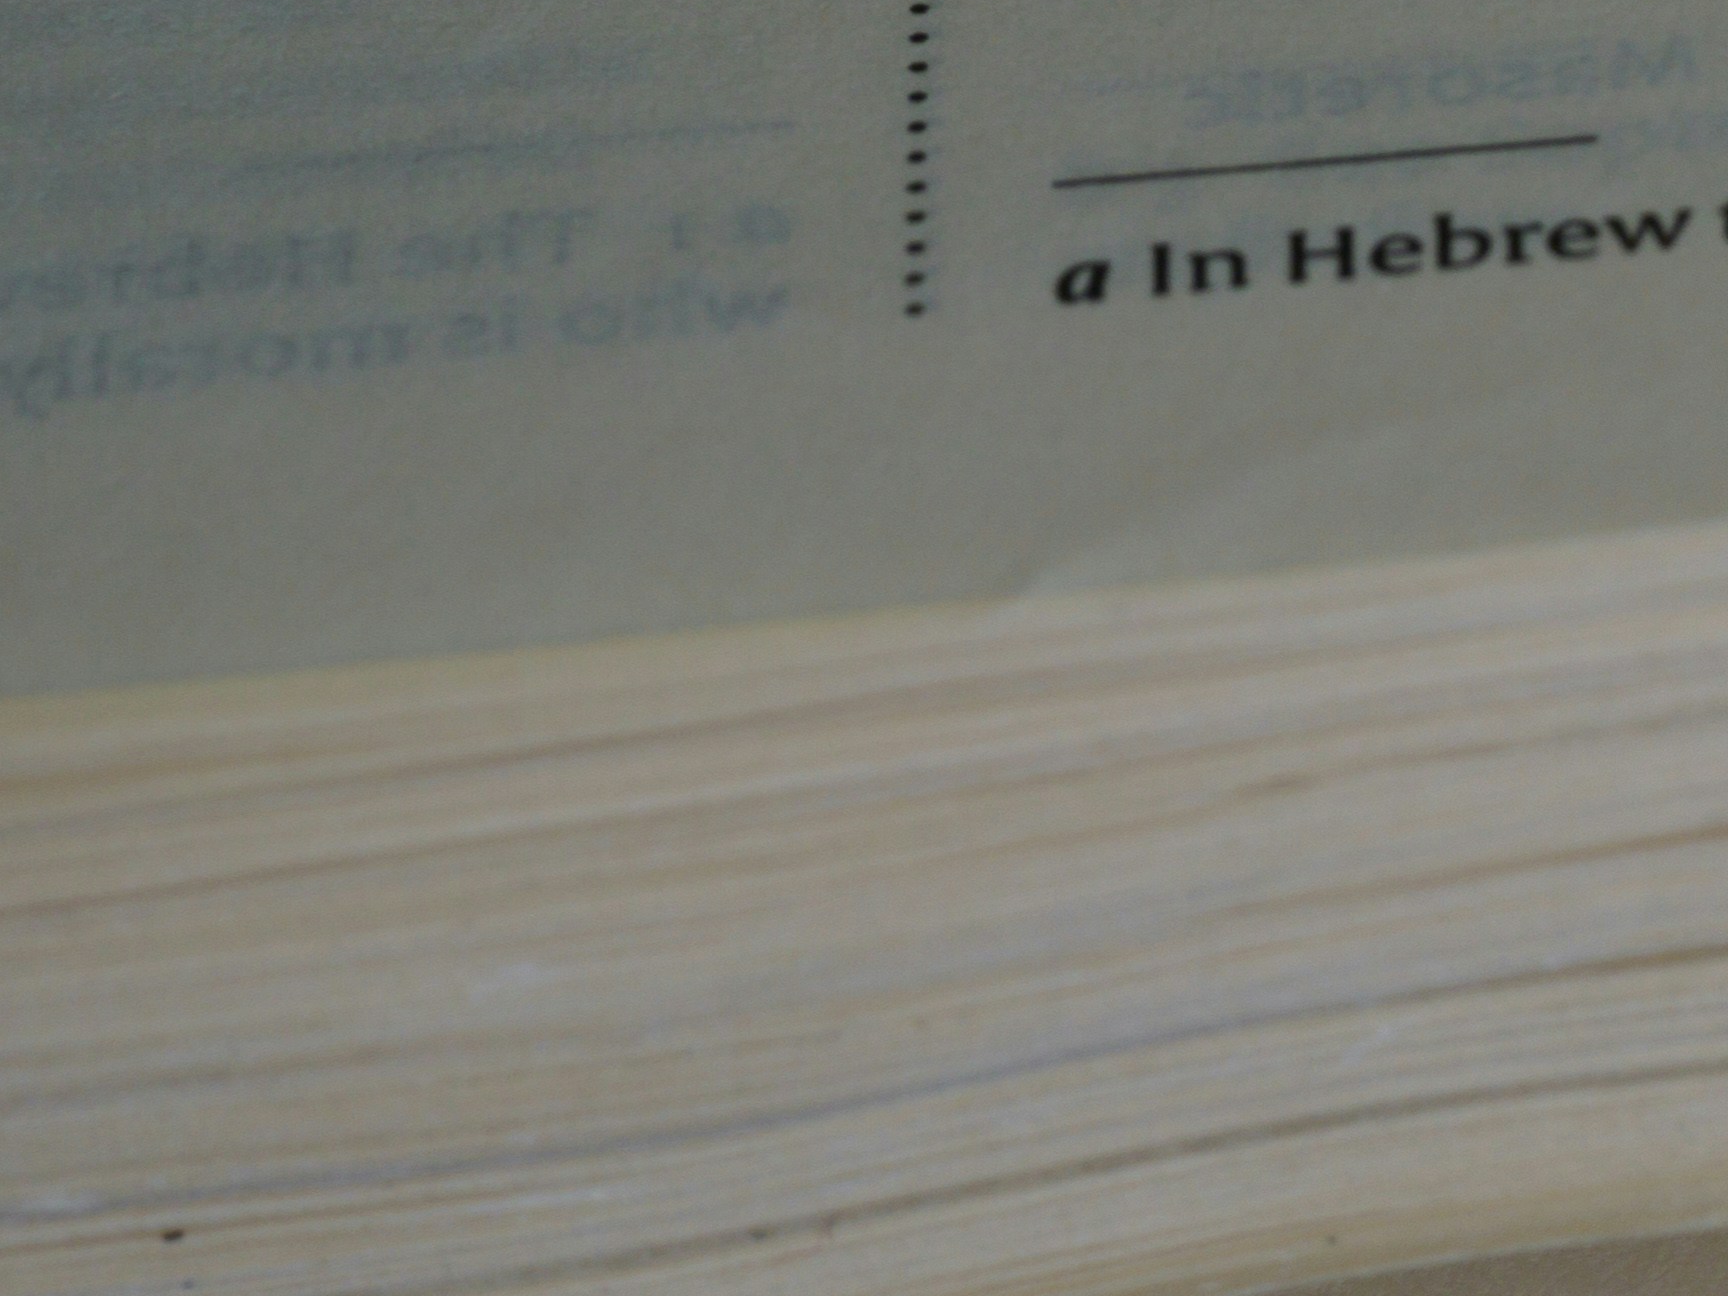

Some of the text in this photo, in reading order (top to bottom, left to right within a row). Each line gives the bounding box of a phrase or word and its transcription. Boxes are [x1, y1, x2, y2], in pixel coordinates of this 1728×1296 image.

[1054, 258, 1111, 305] a
[1150, 243, 1248, 298] In
[1287, 207, 1692, 284] Hebrew
